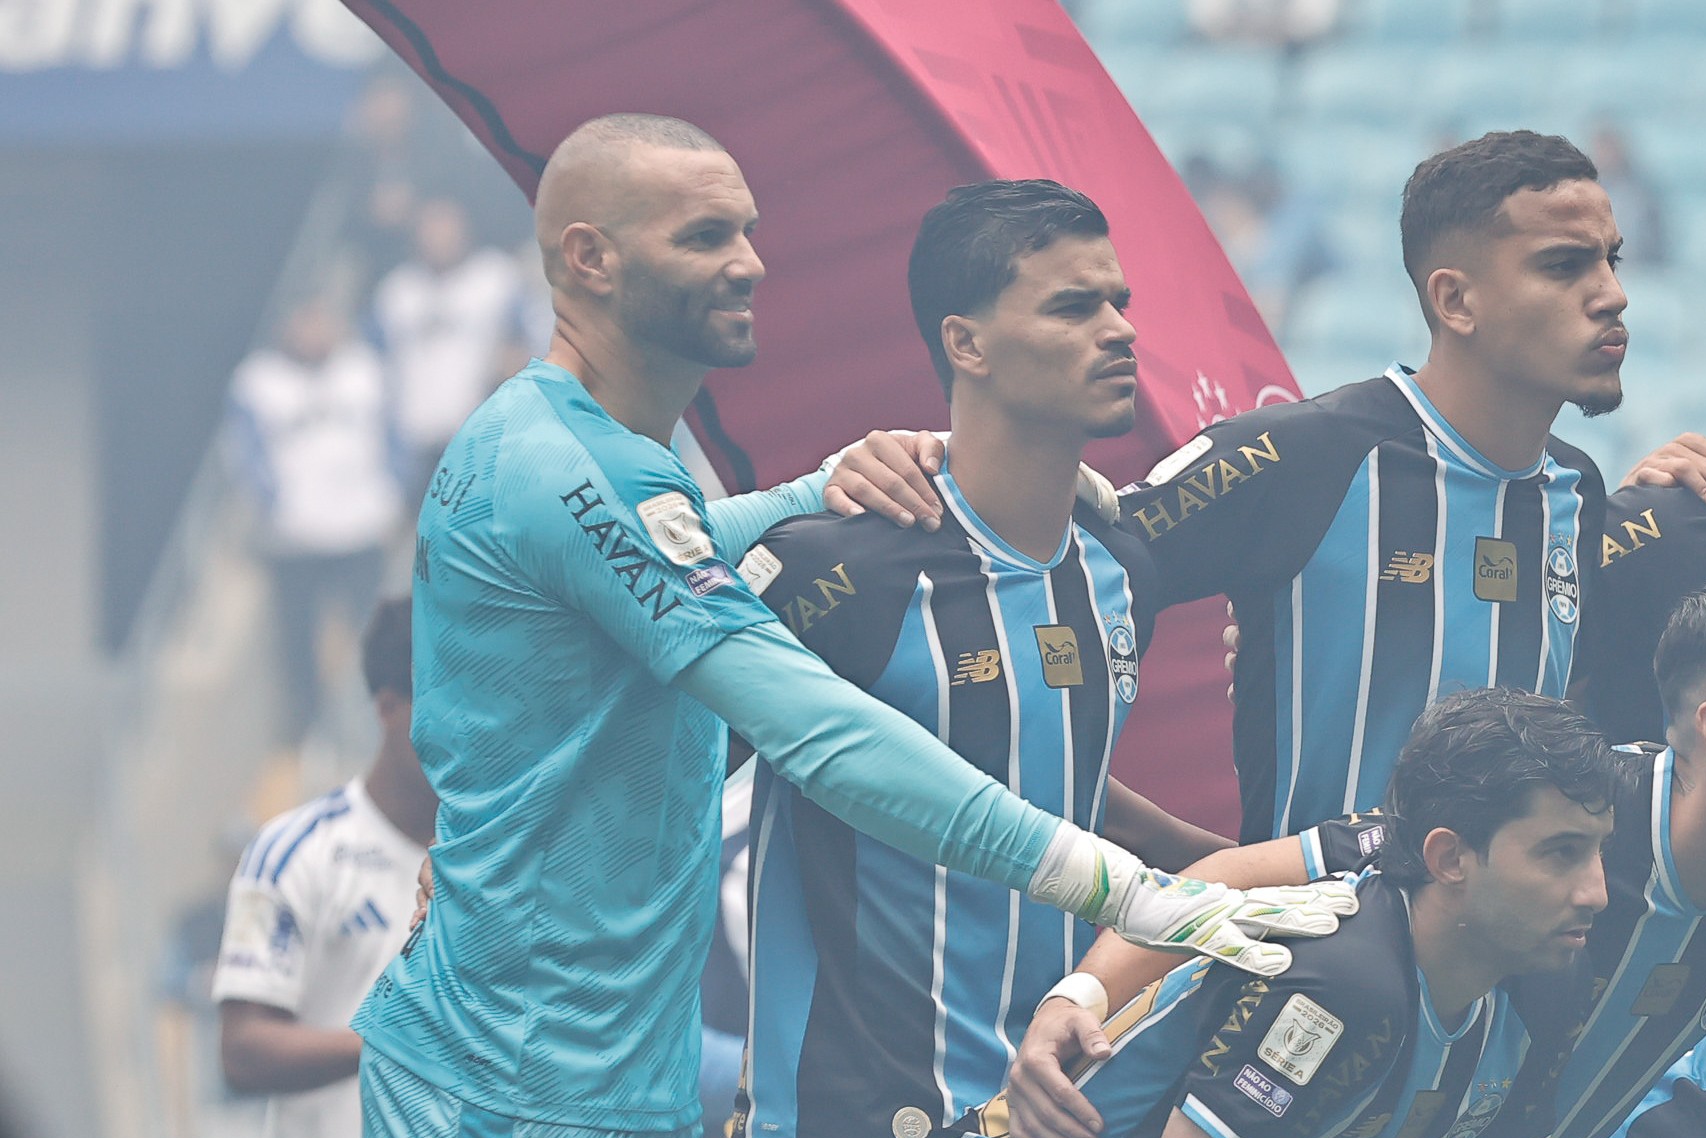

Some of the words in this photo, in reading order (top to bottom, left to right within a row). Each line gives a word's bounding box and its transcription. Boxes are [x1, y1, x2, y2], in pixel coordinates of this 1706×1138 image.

[1132, 431, 1281, 542] HAVAN
[559, 478, 684, 622] HAVAN
[1479, 564, 1511, 580] Coral
[1547, 575, 1577, 599] GRÊMIO
[1045, 651, 1075, 665] Coral
[1300, 1010, 1326, 1030] 2026
[1263, 1047, 1297, 1073] SÉRIE
[1294, 1069, 1304, 1080] A
[1243, 1067, 1260, 1085] NÃO
[1257, 1079, 1272, 1093] AO
[1236, 1078, 1283, 1114] FEMINICÍDIO
